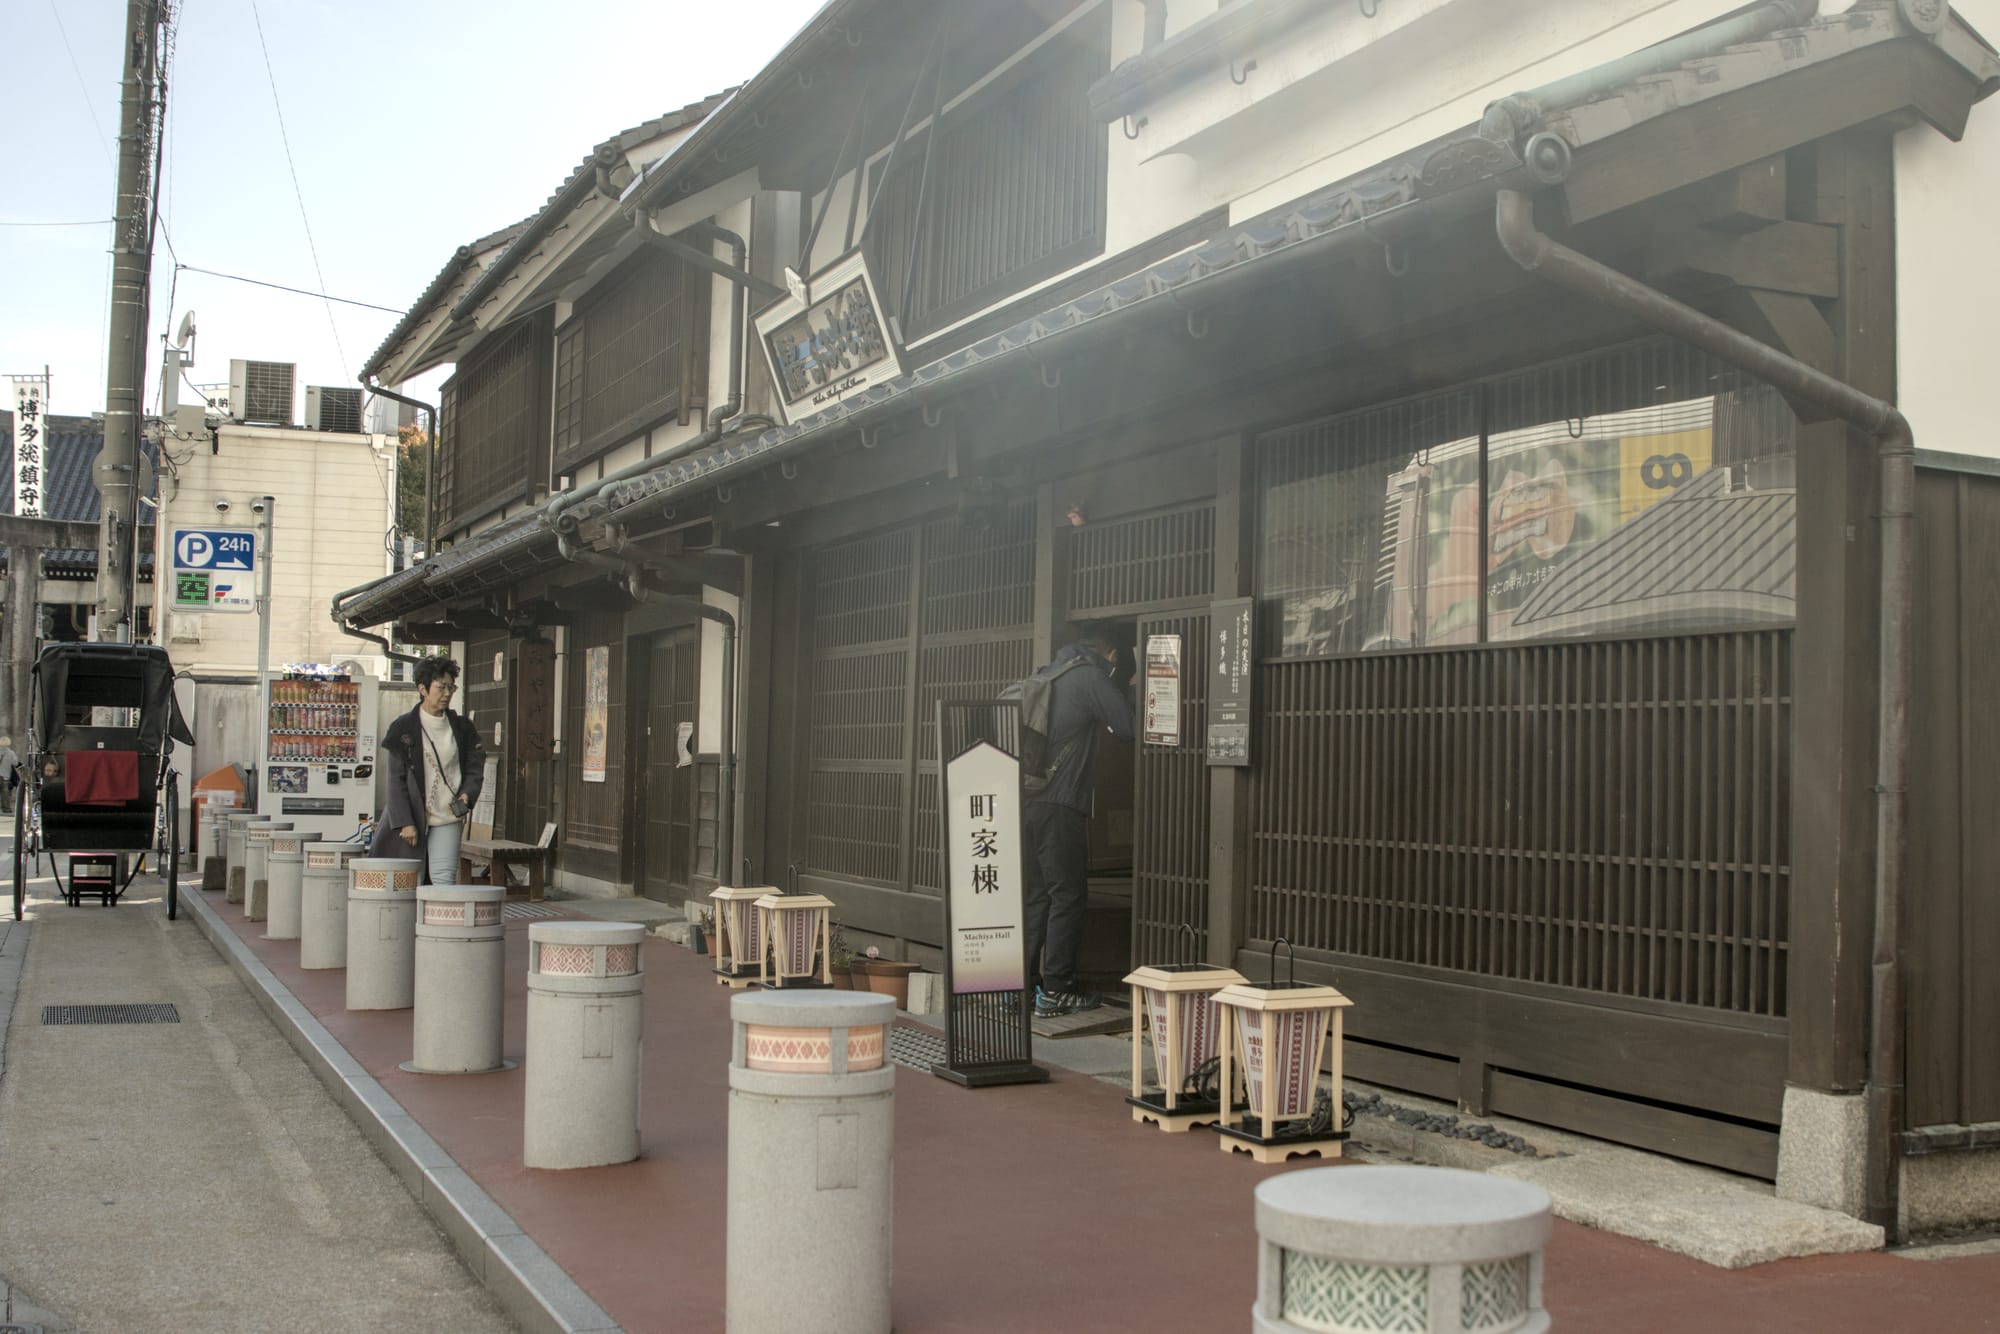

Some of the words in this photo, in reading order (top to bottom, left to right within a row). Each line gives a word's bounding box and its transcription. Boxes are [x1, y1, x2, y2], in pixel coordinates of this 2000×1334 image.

[187, 537, 207, 563] P
[219, 537, 250, 552] 24h
[176, 572, 210, 605] 空
[970, 793, 999, 894] 町家棟
[964, 932, 993, 941] Machiya
[995, 931, 1010, 939] Hall
